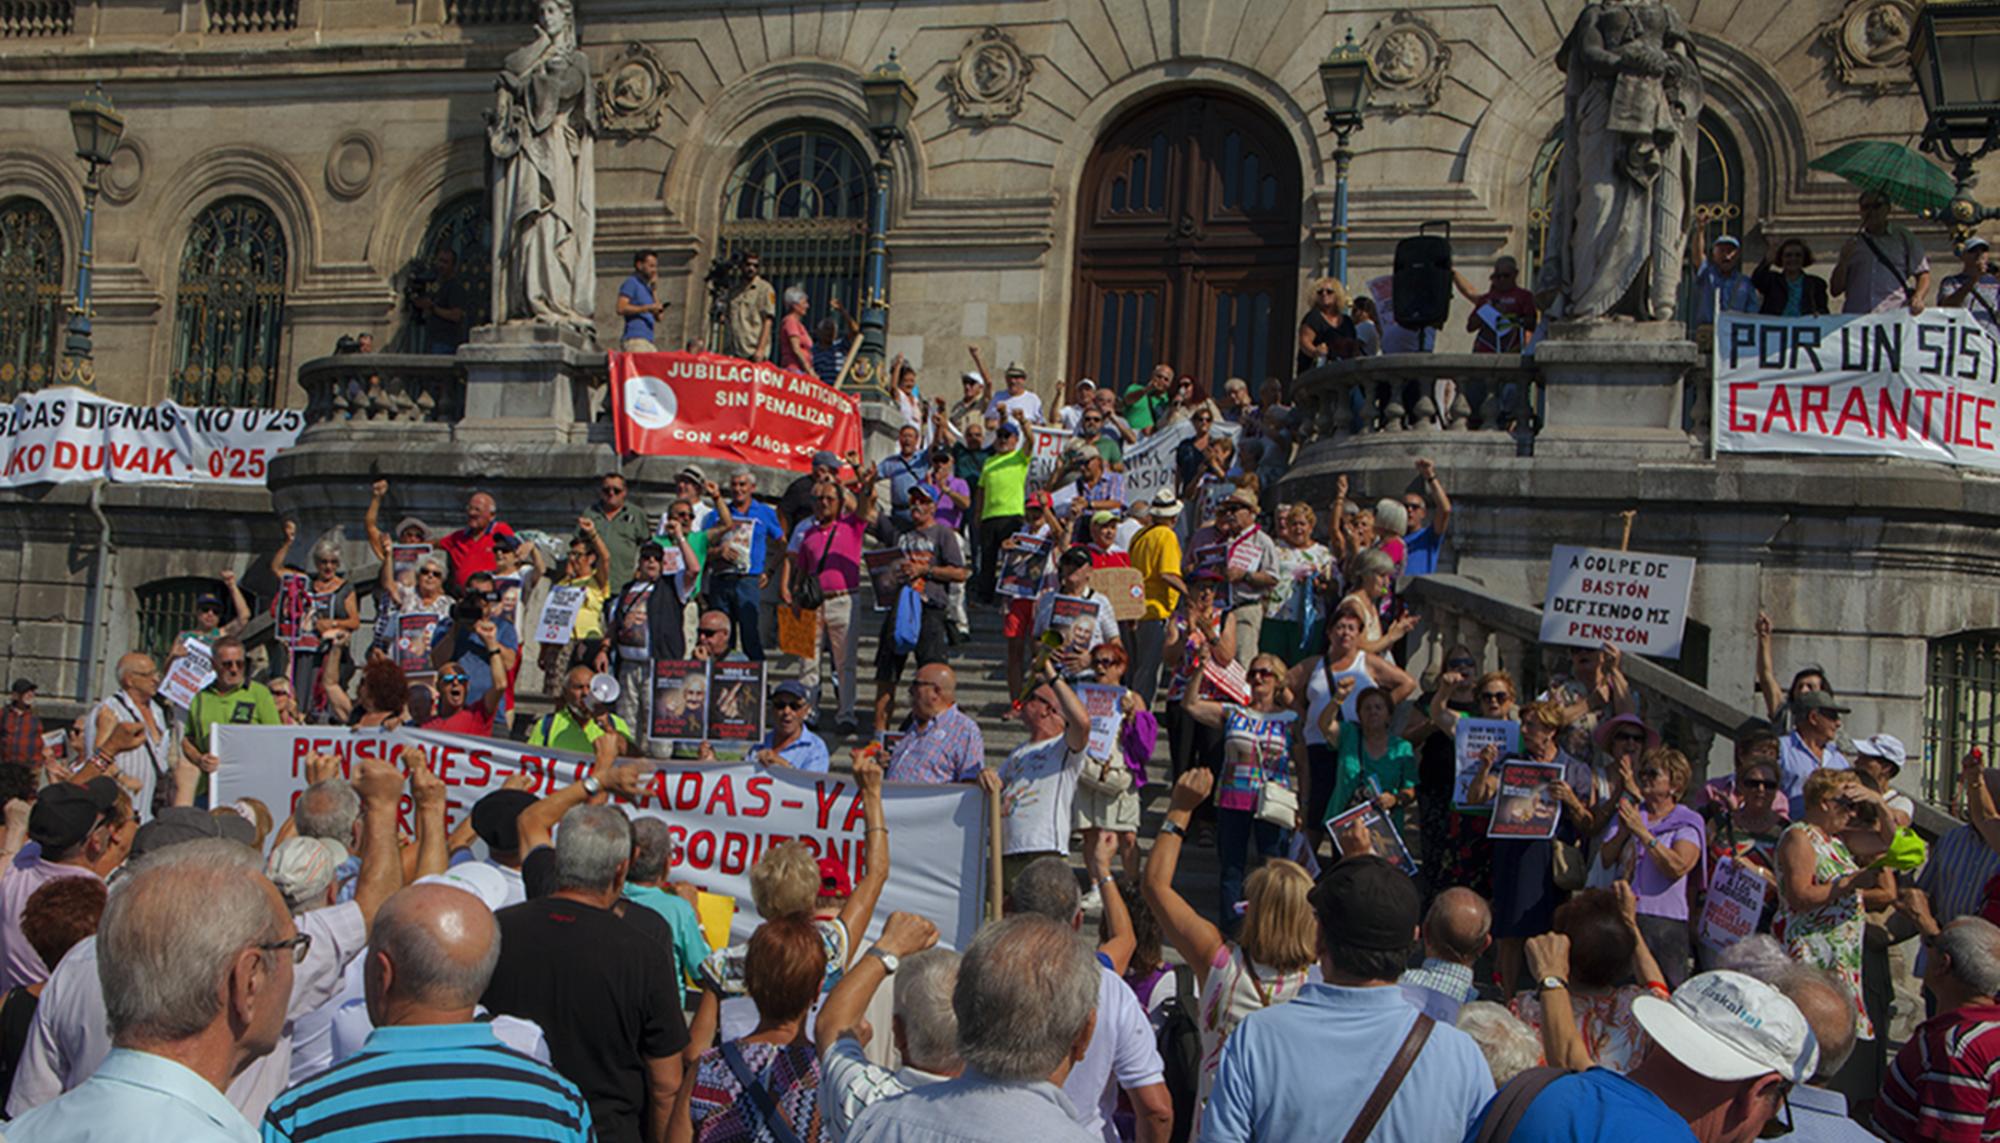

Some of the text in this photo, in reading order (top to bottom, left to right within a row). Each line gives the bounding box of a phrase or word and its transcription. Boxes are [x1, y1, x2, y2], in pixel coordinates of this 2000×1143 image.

[1730, 323, 1823, 372] POR
[1841, 323, 1902, 373] UN
[667, 361, 785, 389] JUBILACIÓN
[195, 408, 234, 432] NO
[715, 390, 835, 429] SIN PENALIZAR
[673, 428, 712, 444] CON
[718, 429, 750, 444] +40
[751, 434, 791, 455] AÑOS
[208, 446, 265, 478] 0'25
[1569, 554, 1580, 570] A
[1644, 562, 1670, 579] DE
[1581, 577, 1650, 600] BASTÓN
[1553, 597, 1671, 625] DEFIENDO MI
[1568, 621, 1649, 646] PENSIÓN
